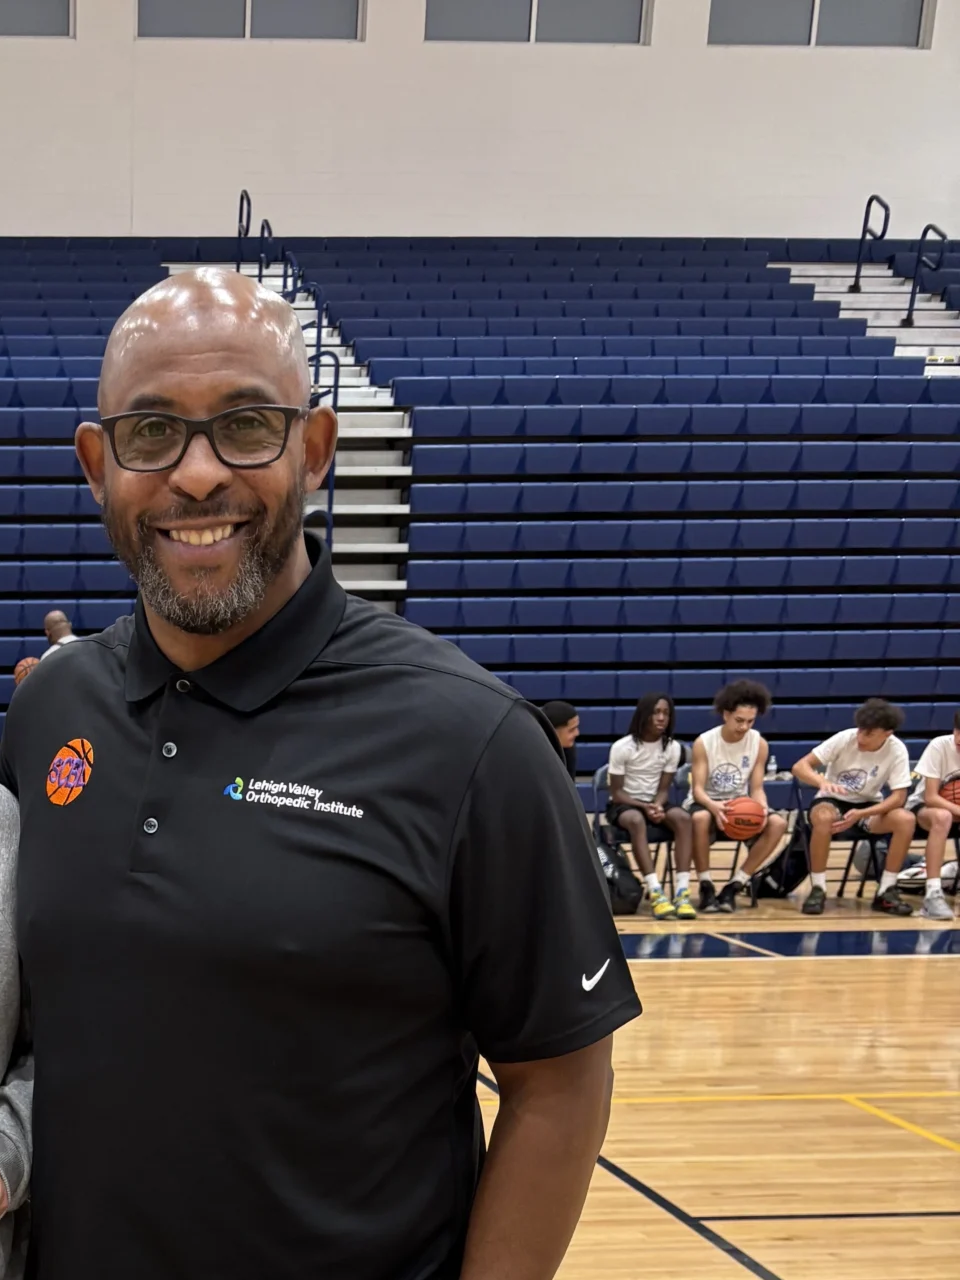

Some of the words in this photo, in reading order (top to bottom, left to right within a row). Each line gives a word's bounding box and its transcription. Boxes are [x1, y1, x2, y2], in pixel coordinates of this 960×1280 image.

[49, 757, 85, 788] SCBL
[248, 778, 288, 794] Lehigh
[288, 782, 323, 800] Valley
[245, 791, 311, 807] Orthopedic
[313, 799, 364, 818] Institute
